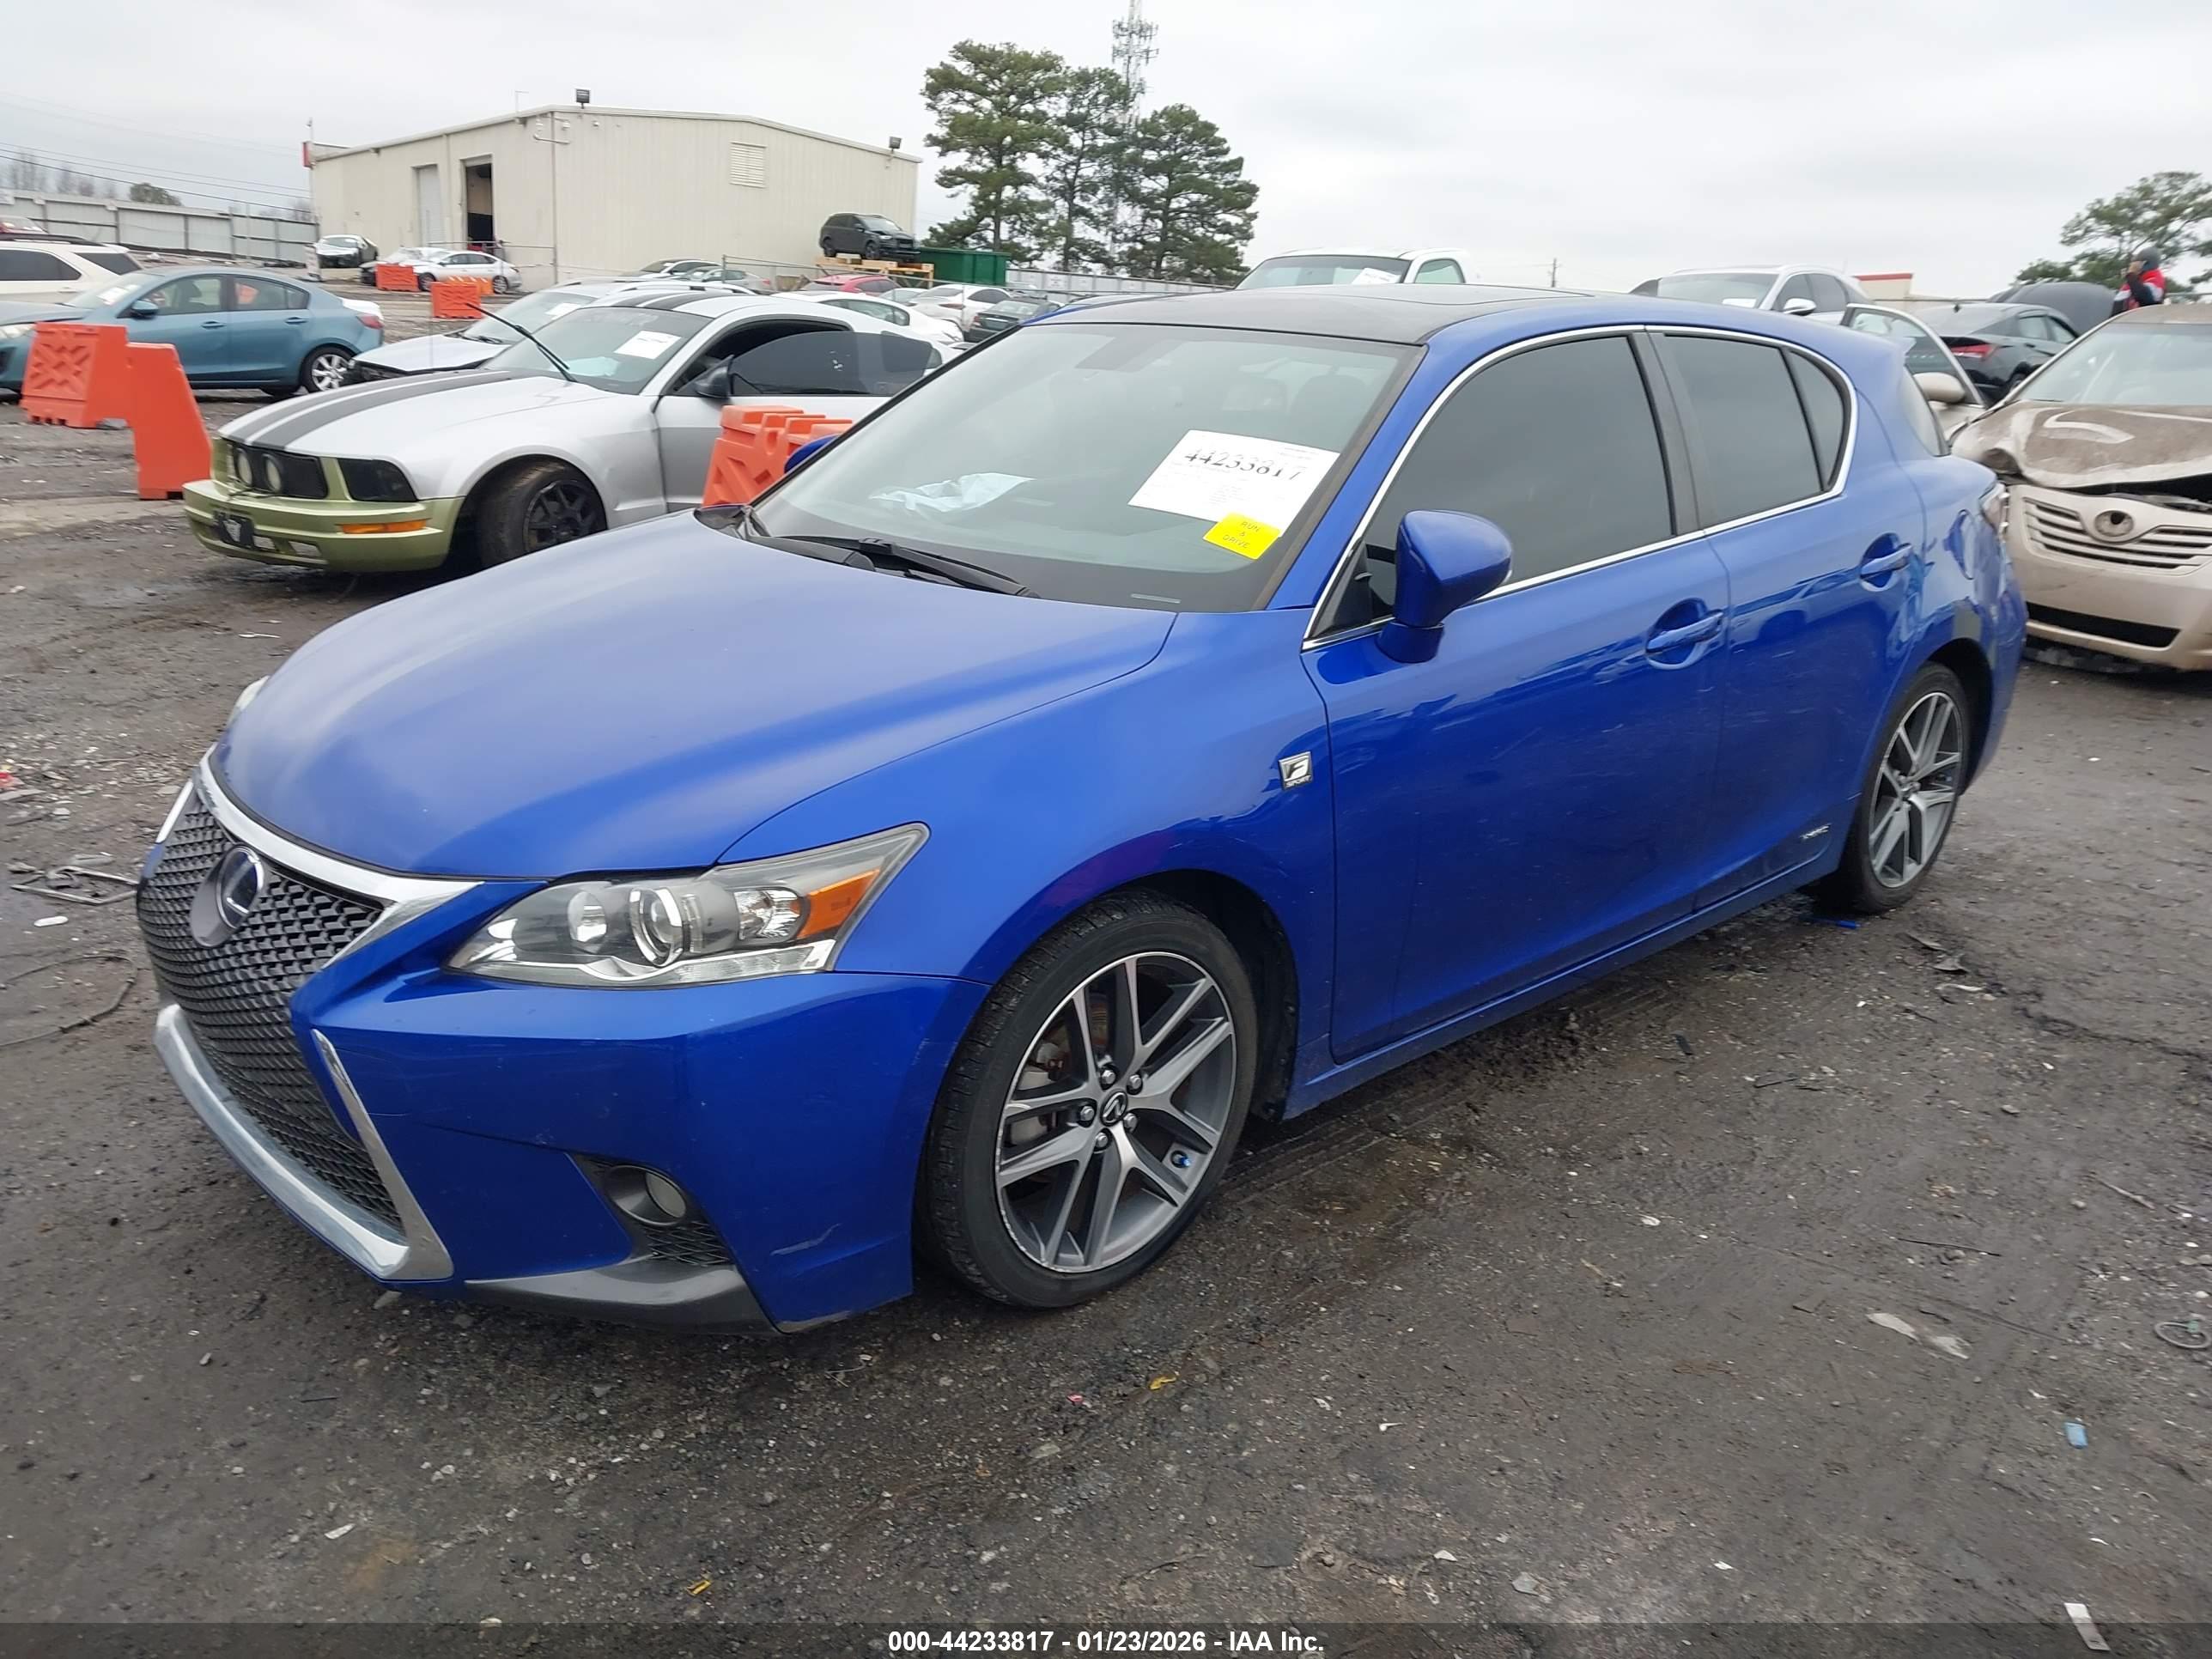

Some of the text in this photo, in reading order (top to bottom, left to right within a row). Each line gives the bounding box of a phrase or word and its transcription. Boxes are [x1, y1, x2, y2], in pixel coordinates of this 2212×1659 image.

[1184, 448, 1307, 480] 44233817
[1241, 520, 1261, 533] RUN
[1222, 534, 1251, 549] DRIVE
